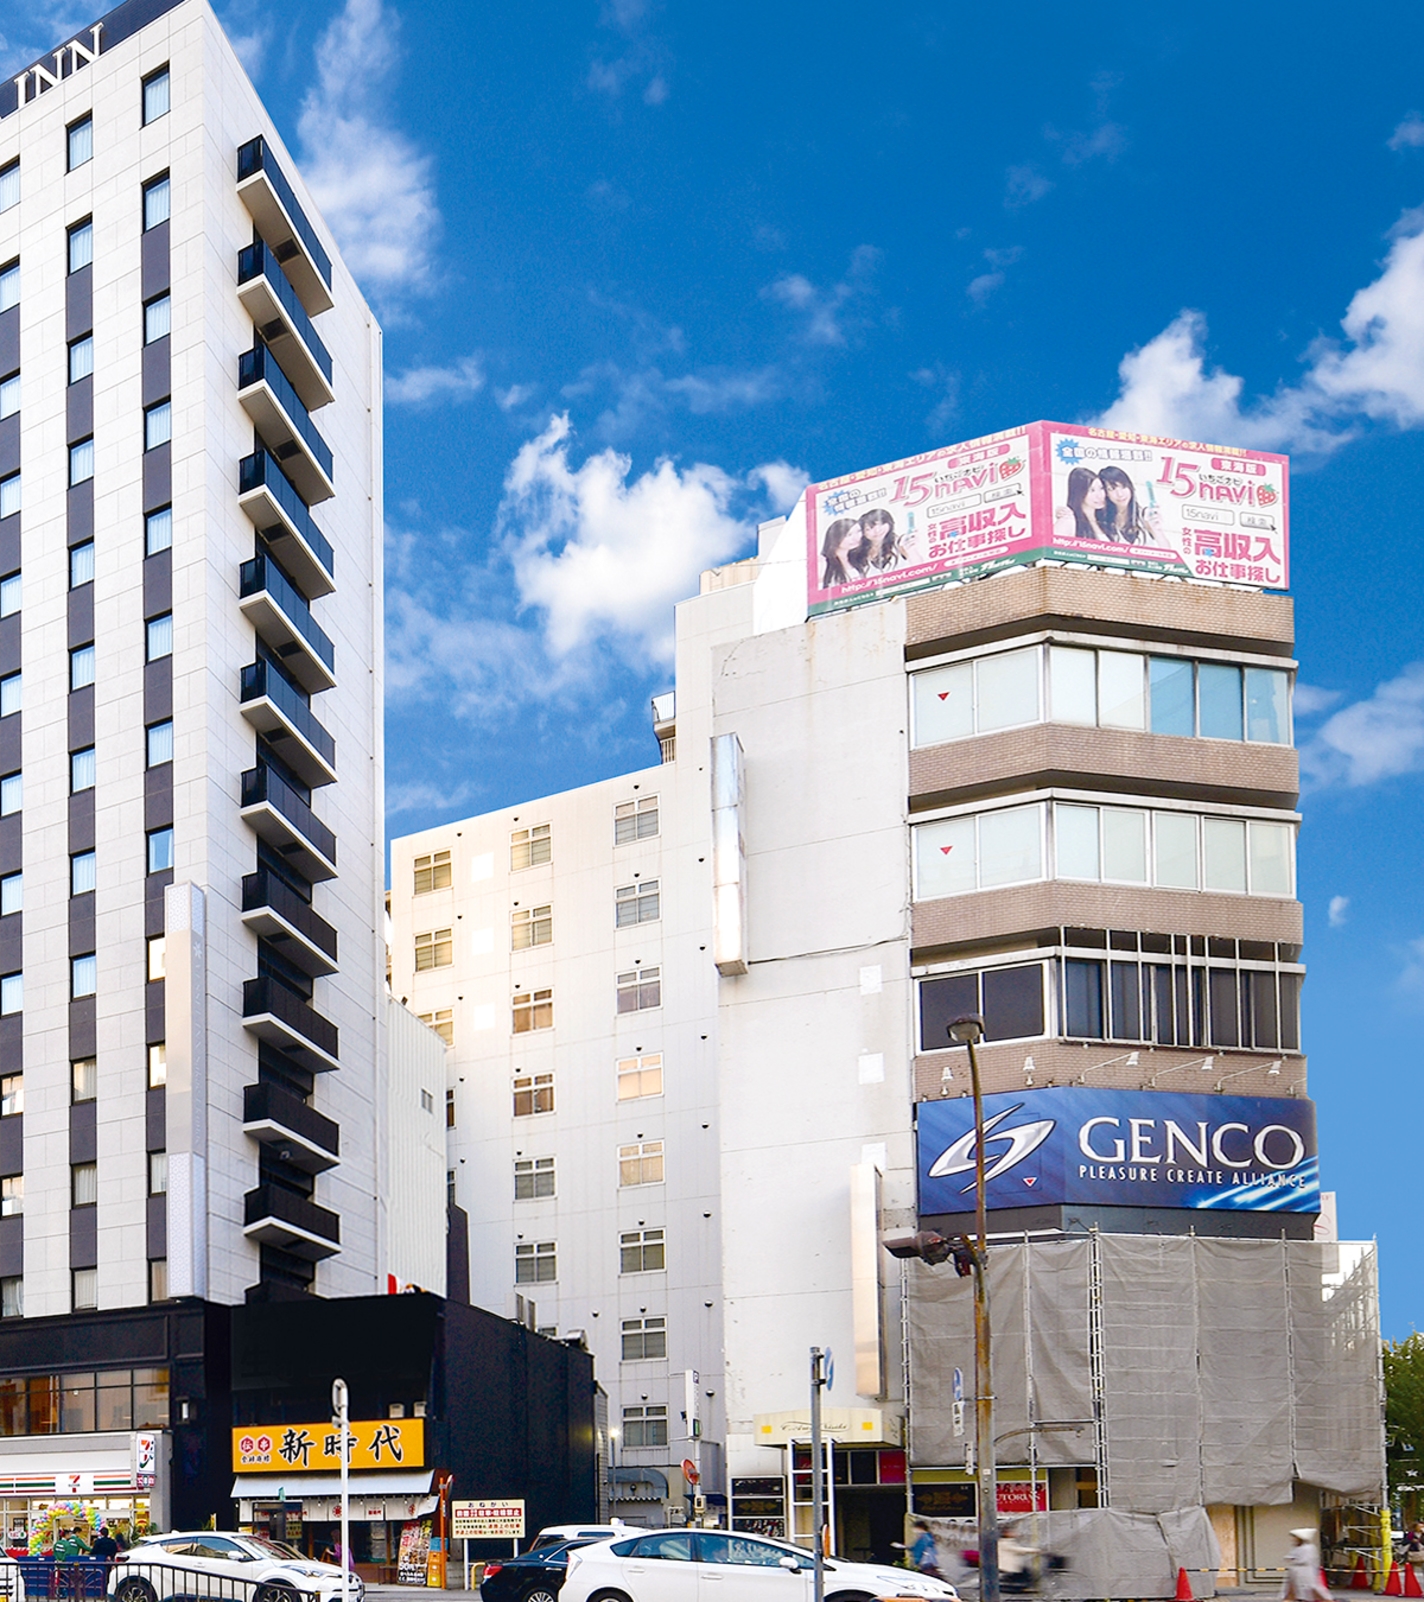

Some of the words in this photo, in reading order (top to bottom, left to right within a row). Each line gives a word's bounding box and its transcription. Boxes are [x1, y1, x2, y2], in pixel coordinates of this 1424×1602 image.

[14, 22, 104, 109] INN
[1156, 456, 1200, 498] 15
[1220, 459, 1258, 475] 東海版
[889, 472, 936, 507] 15
[939, 503, 1026, 541] 高収入
[928, 527, 1025, 559] お仕事探し
[1194, 529, 1281, 565] 高収入
[1195, 560, 1281, 584] お仕事探し
[1078, 1116, 1305, 1170] GENCO
[1079, 1164, 1157, 1182] PLEASURE
[1166, 1167, 1224, 1185] CREATE
[1231, 1172, 1306, 1189] ALLIANCE
[278, 1424, 403, 1467] 新時代
